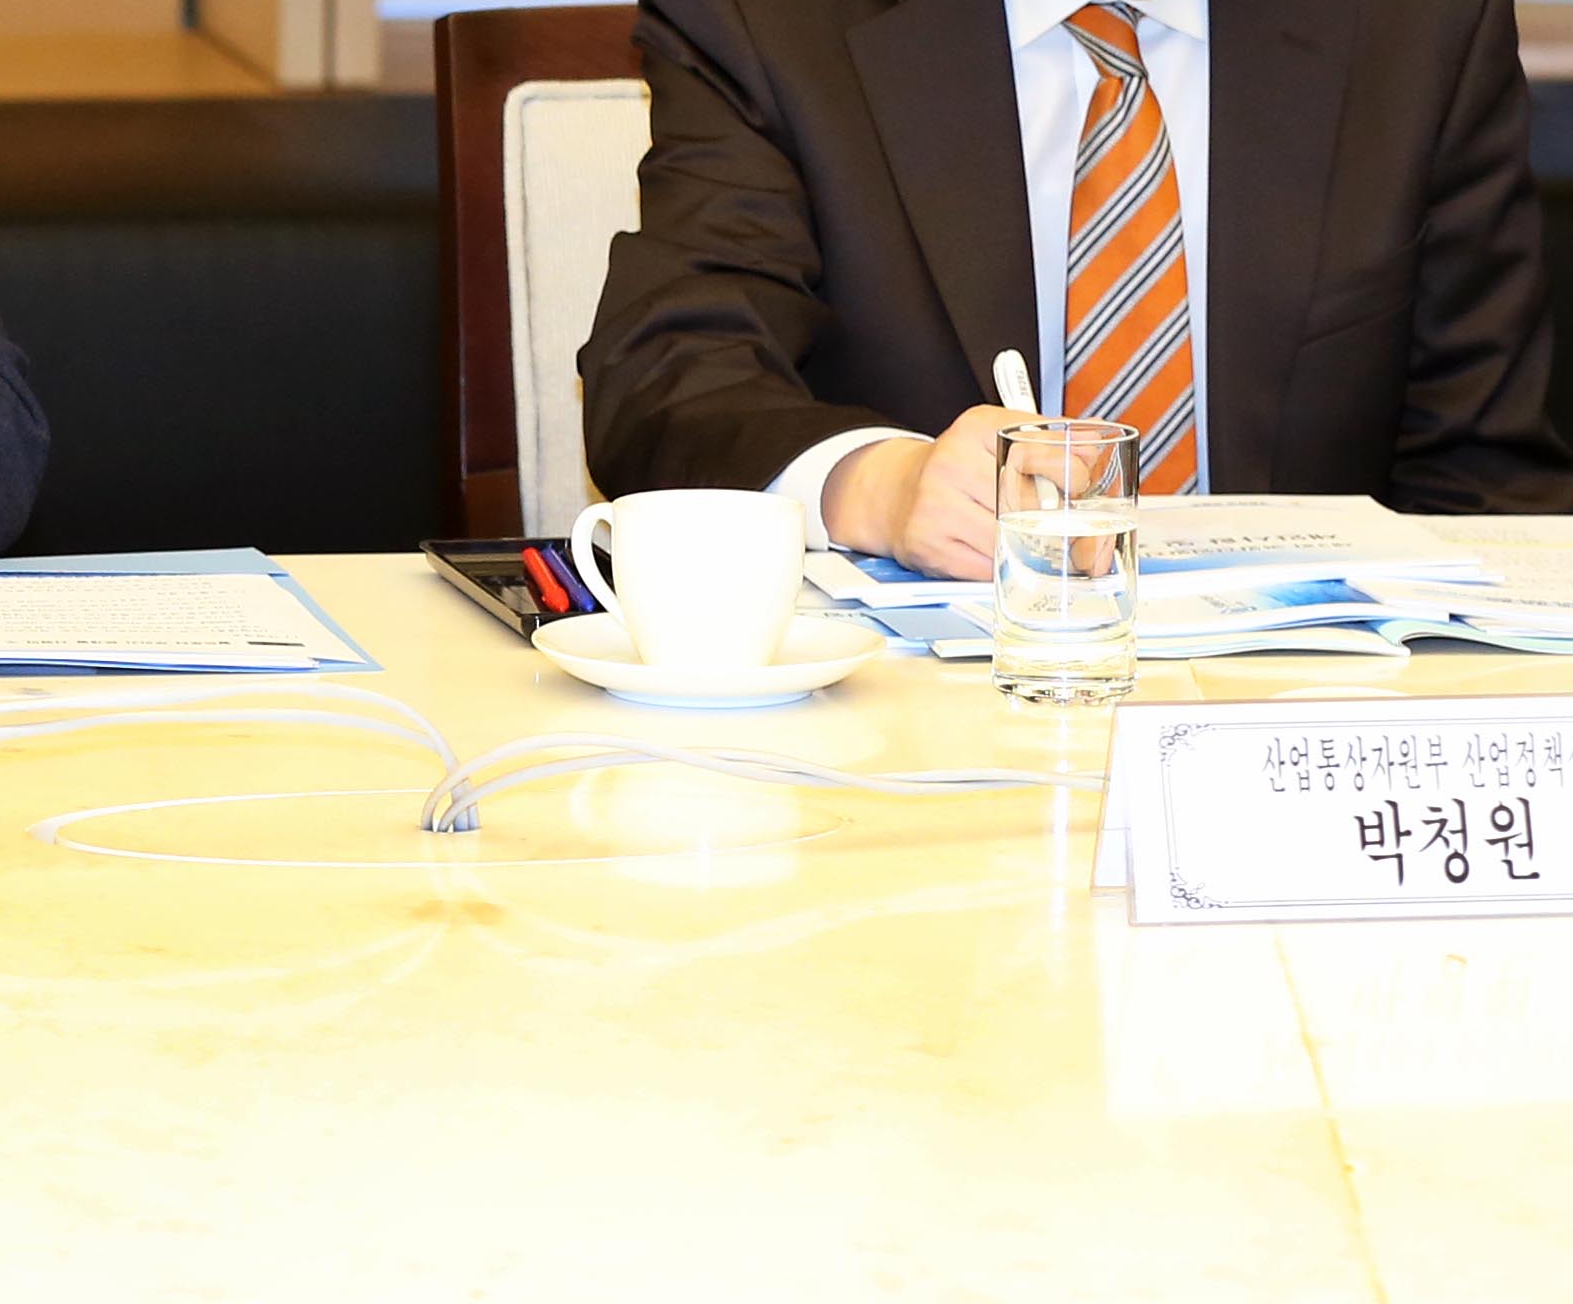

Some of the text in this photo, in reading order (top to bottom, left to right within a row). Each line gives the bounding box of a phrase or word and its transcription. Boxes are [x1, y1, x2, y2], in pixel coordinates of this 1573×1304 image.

[1263, 731, 1573, 793] 산업통상자원부 산업정책
[1353, 797, 1541, 886] 박청원
